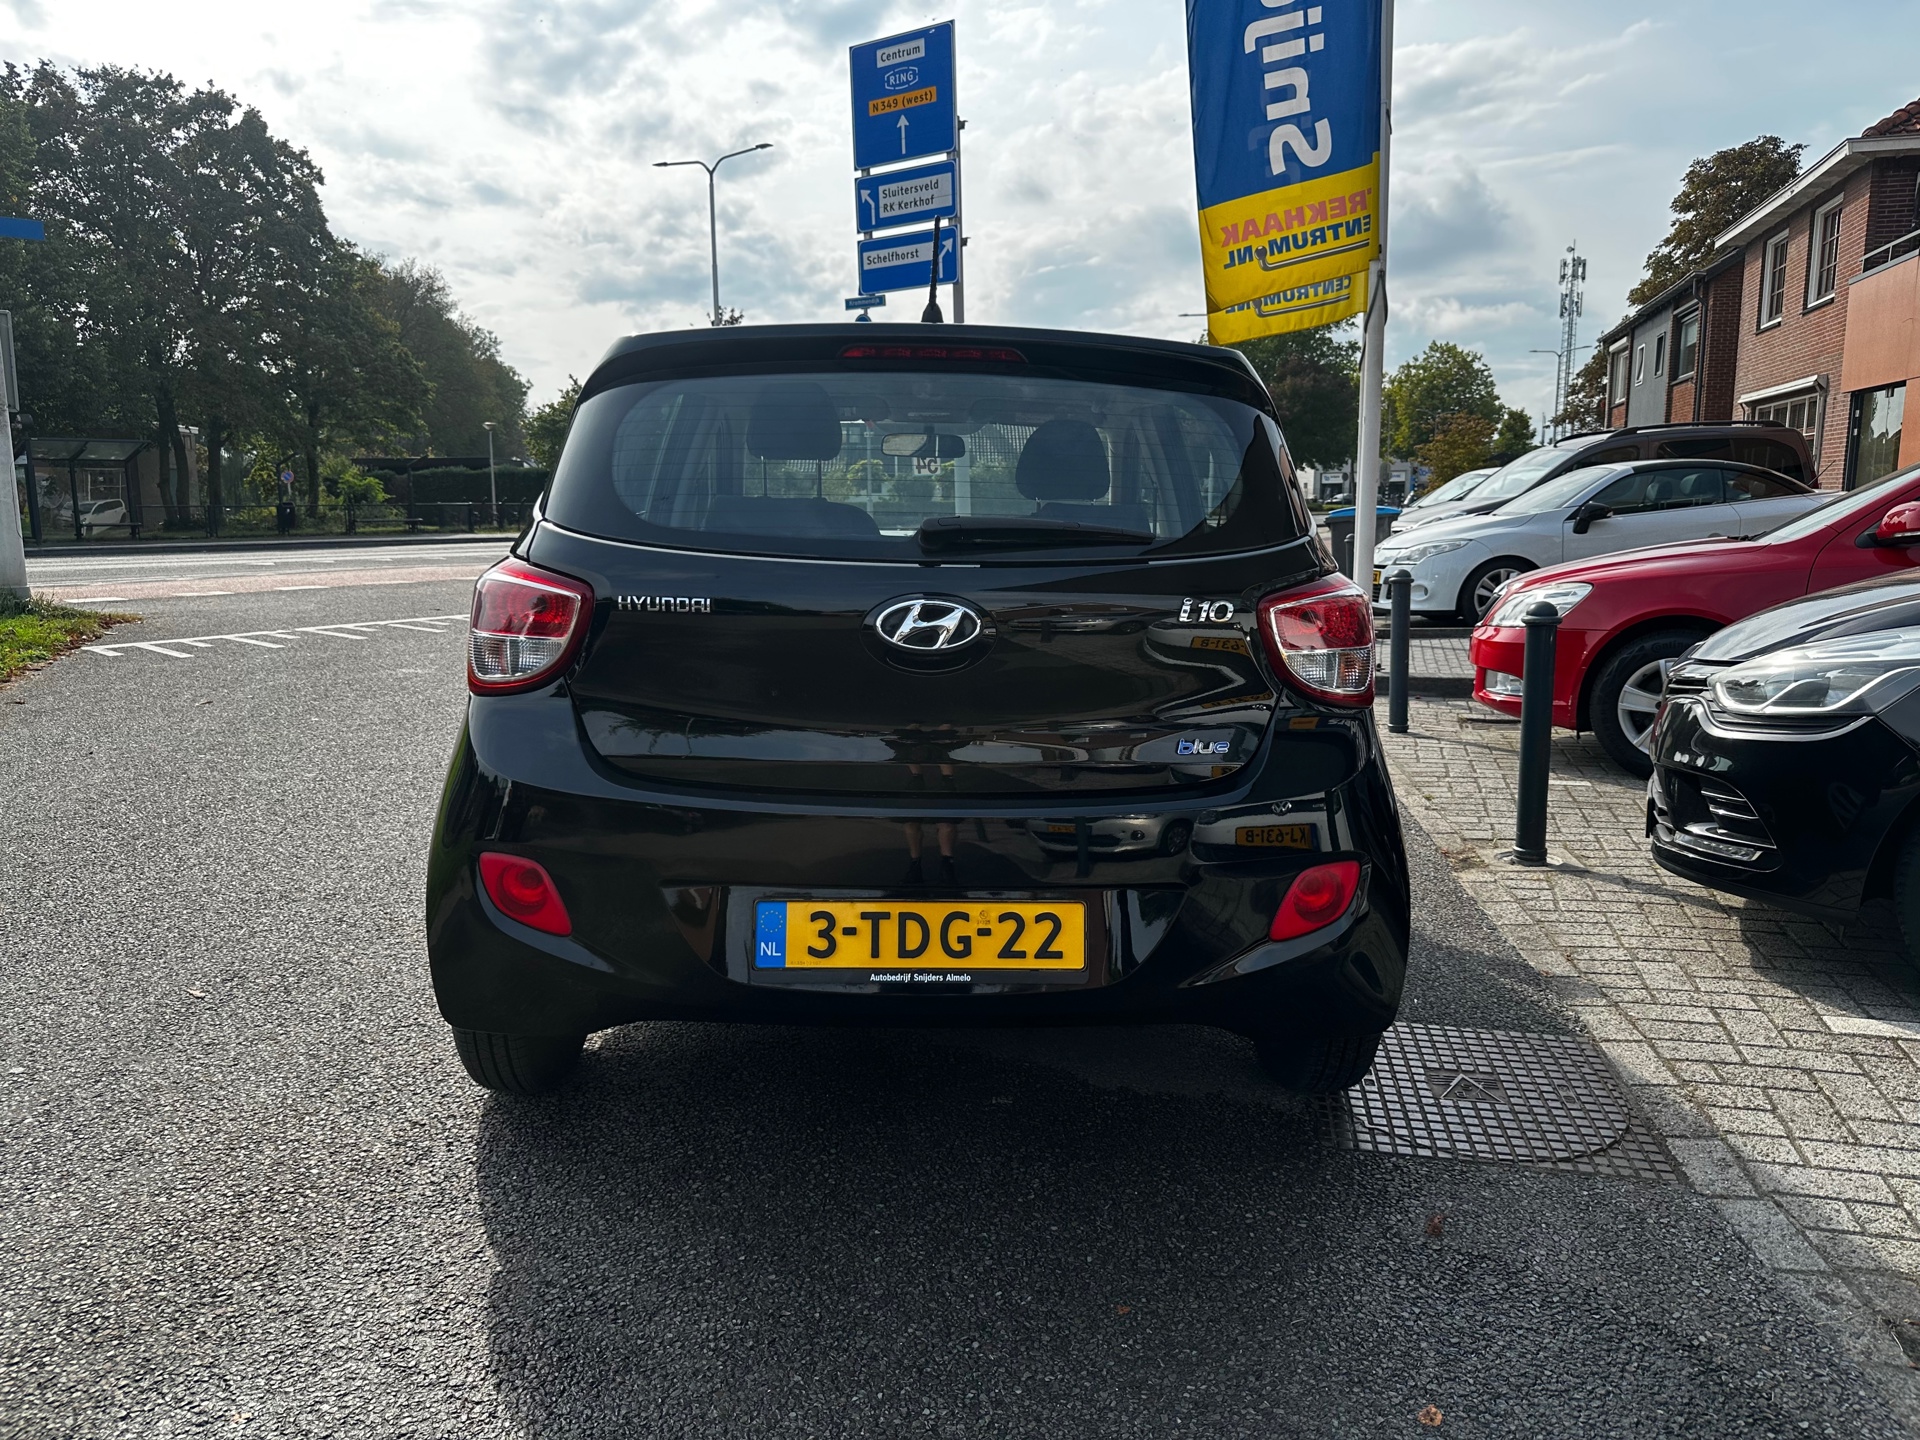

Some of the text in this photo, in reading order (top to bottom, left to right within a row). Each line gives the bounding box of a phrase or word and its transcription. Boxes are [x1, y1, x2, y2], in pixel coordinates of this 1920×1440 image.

[880, 45, 920, 62] Centrum
[889, 71, 914, 86] RING
[902, 90, 933, 108] (west)
[882, 179, 939, 199] Sluitersveld
[883, 195, 935, 213] RK Kerkhof
[866, 248, 919, 266] Schelfhorst
[617, 595, 711, 613] HYUNDAI
[1178, 597, 1234, 623] i10
[1176, 738, 1231, 755] blue
[807, 910, 1064, 960] 3-TDG-22
[760, 941, 782, 956] NL
[869, 973, 971, 983] Autobedrijf Snijders Almelo
